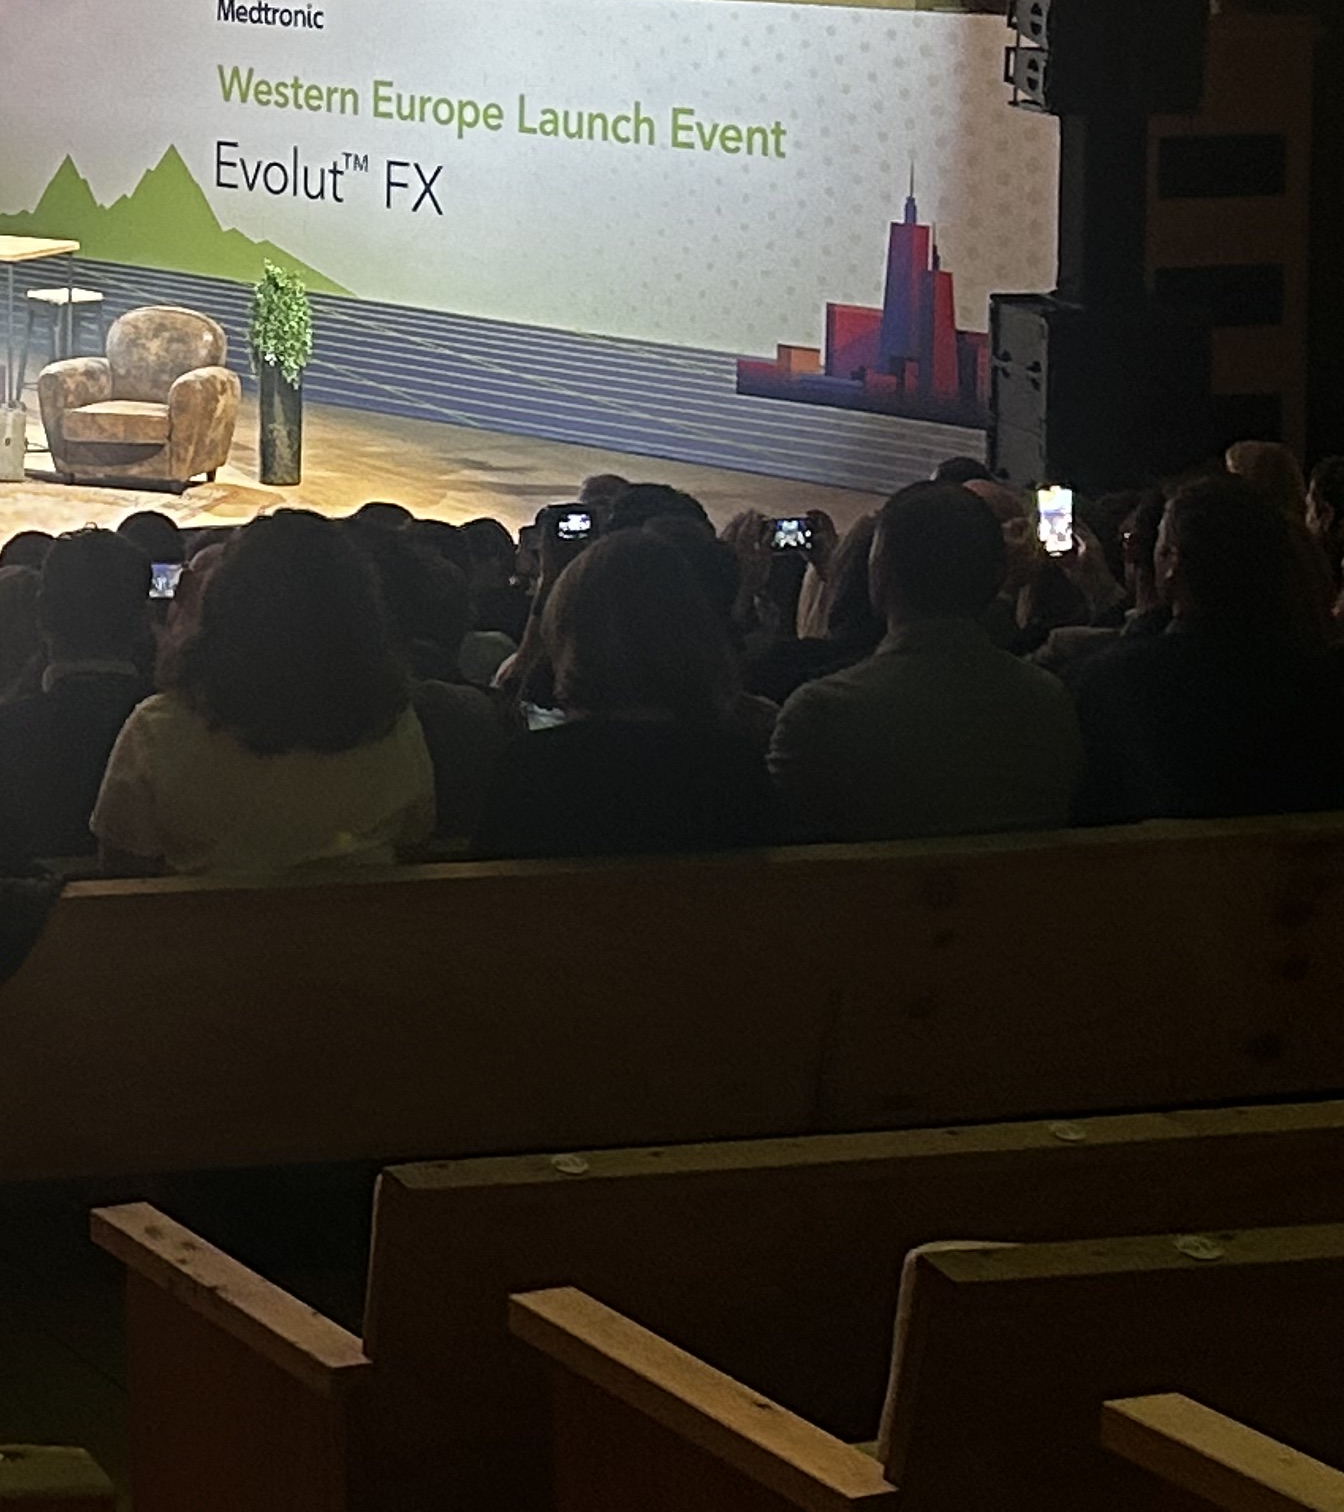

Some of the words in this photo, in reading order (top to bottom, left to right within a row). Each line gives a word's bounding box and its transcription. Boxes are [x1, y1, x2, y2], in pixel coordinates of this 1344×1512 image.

[216, 64, 360, 116] Western
[372, 79, 504, 140] Europe
[517, 93, 656, 146] Launch
[670, 106, 788, 159] Event
[385, 159, 444, 216] FX
